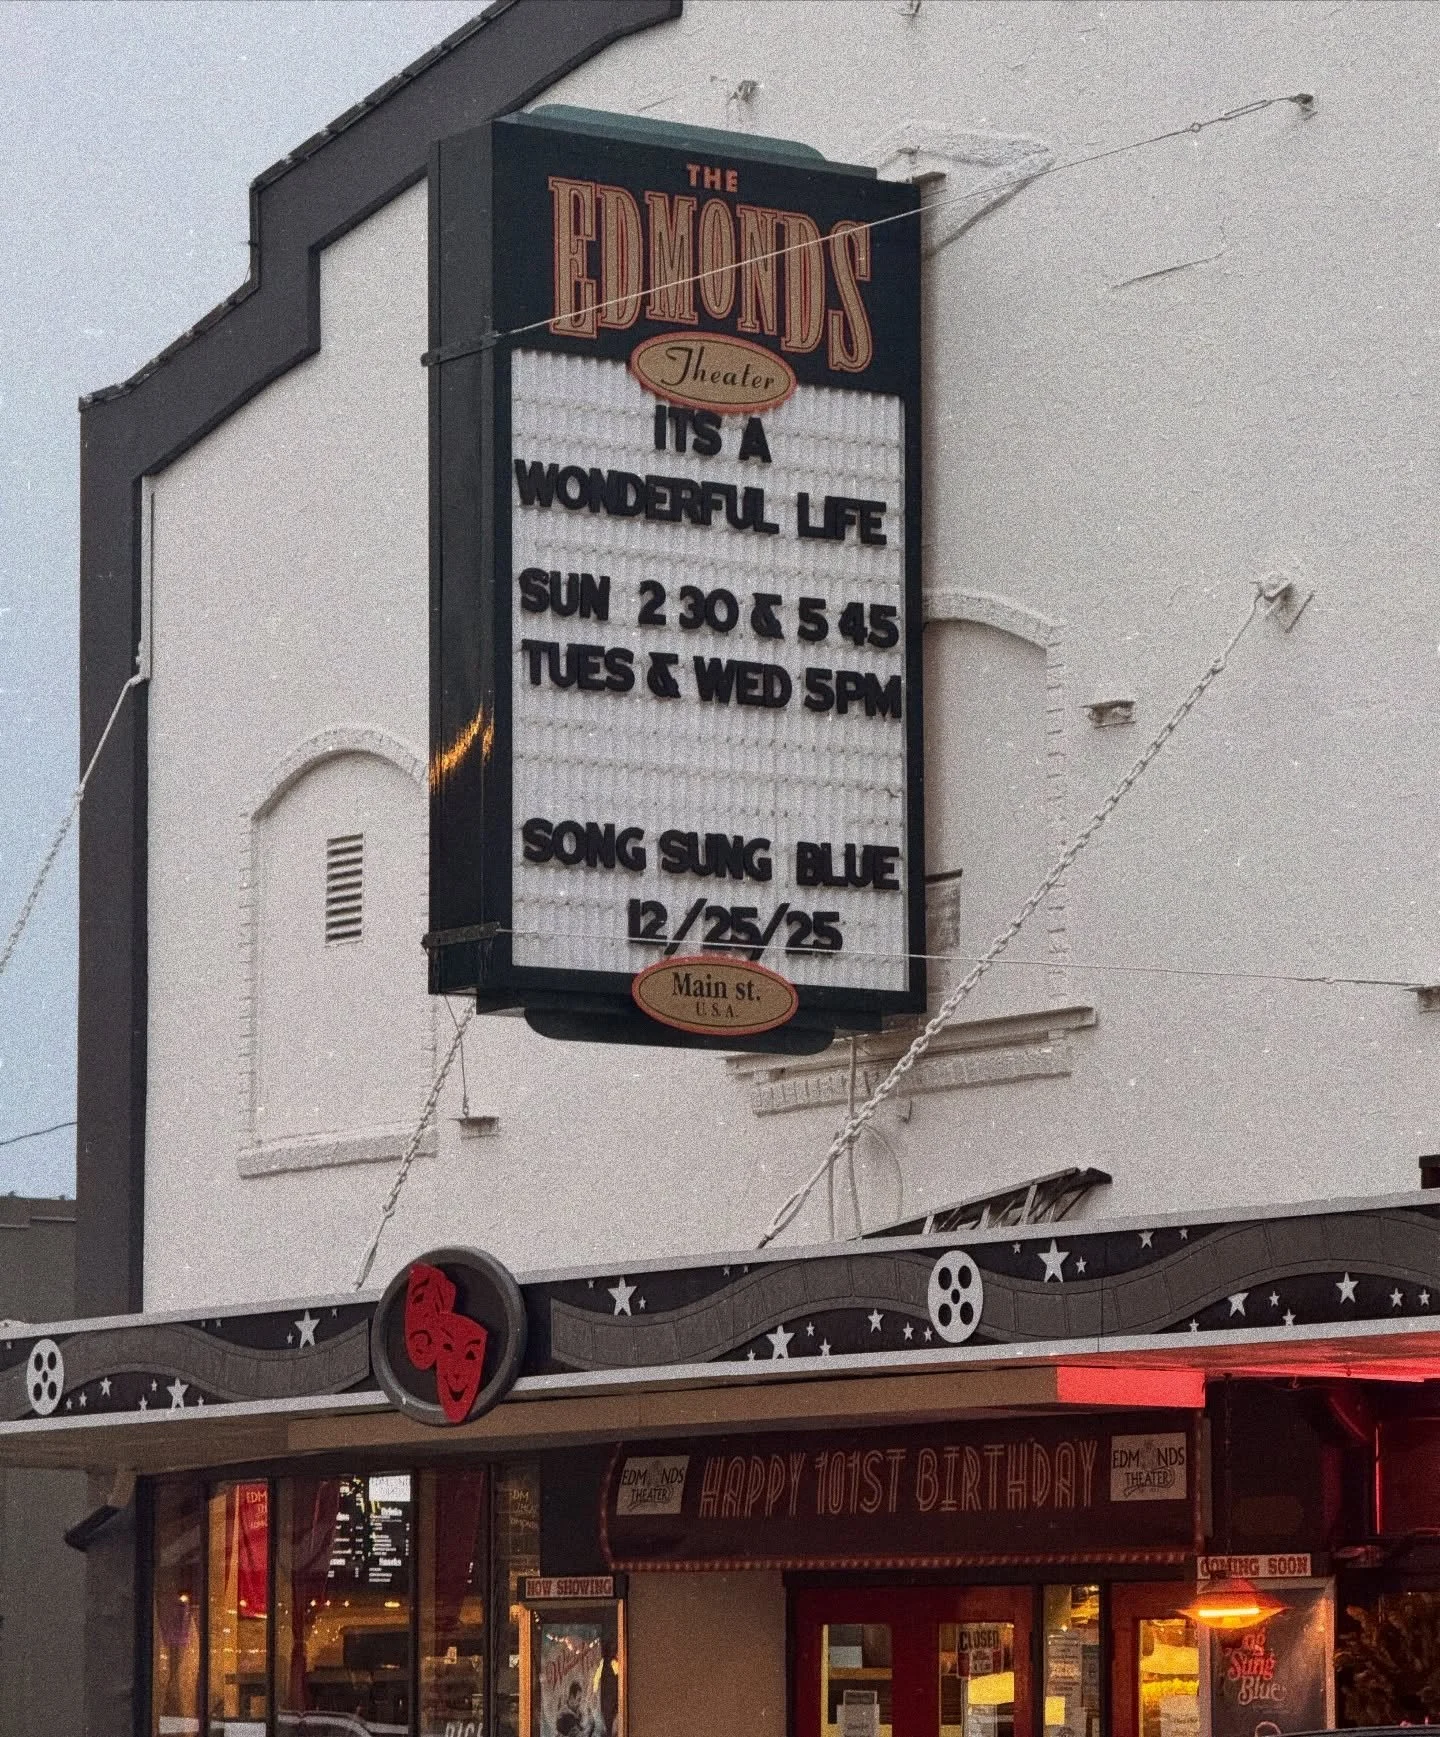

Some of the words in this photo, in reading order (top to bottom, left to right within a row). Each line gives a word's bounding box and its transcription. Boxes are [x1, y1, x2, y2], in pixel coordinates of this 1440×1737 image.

[687, 163, 738, 193] THE
[548, 176, 873, 373] EDMONDS
[660, 346, 775, 390] Theater
[654, 404, 722, 457] ITS
[738, 417, 772, 463] A
[514, 460, 780, 534] WONDERFUL
[797, 493, 887, 546] LIFE
[518, 568, 611, 621] SUN
[750, 592, 785, 640] &
[522, 639, 635, 693] TUES
[646, 652, 681, 699] &
[693, 656, 793, 709] WED
[804, 668, 901, 719] 5PM
[522, 818, 647, 871] SONG
[659, 830, 773, 882] SUNG
[796, 842, 900, 892] BLUE
[627, 898, 843, 961] 12/25/25
[672, 972, 729, 998] Main
[735, 981, 761, 1001] st.
[631, 1487, 668, 1502] THEATER
[700, 1451, 806, 1520] HAPPY
[815, 1450, 907, 1516] 101ST
[916, 1440, 1098, 1512] BIRTHDAY
[1125, 1471, 1169, 1487] THEATER
[527, 1579, 551, 1597] NOW
[557, 1577, 612, 1596] SHOWING
[1200, 1557, 1260, 1577] COMING
[1268, 1556, 1308, 1575] SOON
[959, 1630, 1000, 1650] CLOSED
[1238, 1675, 1288, 1706] Blue
